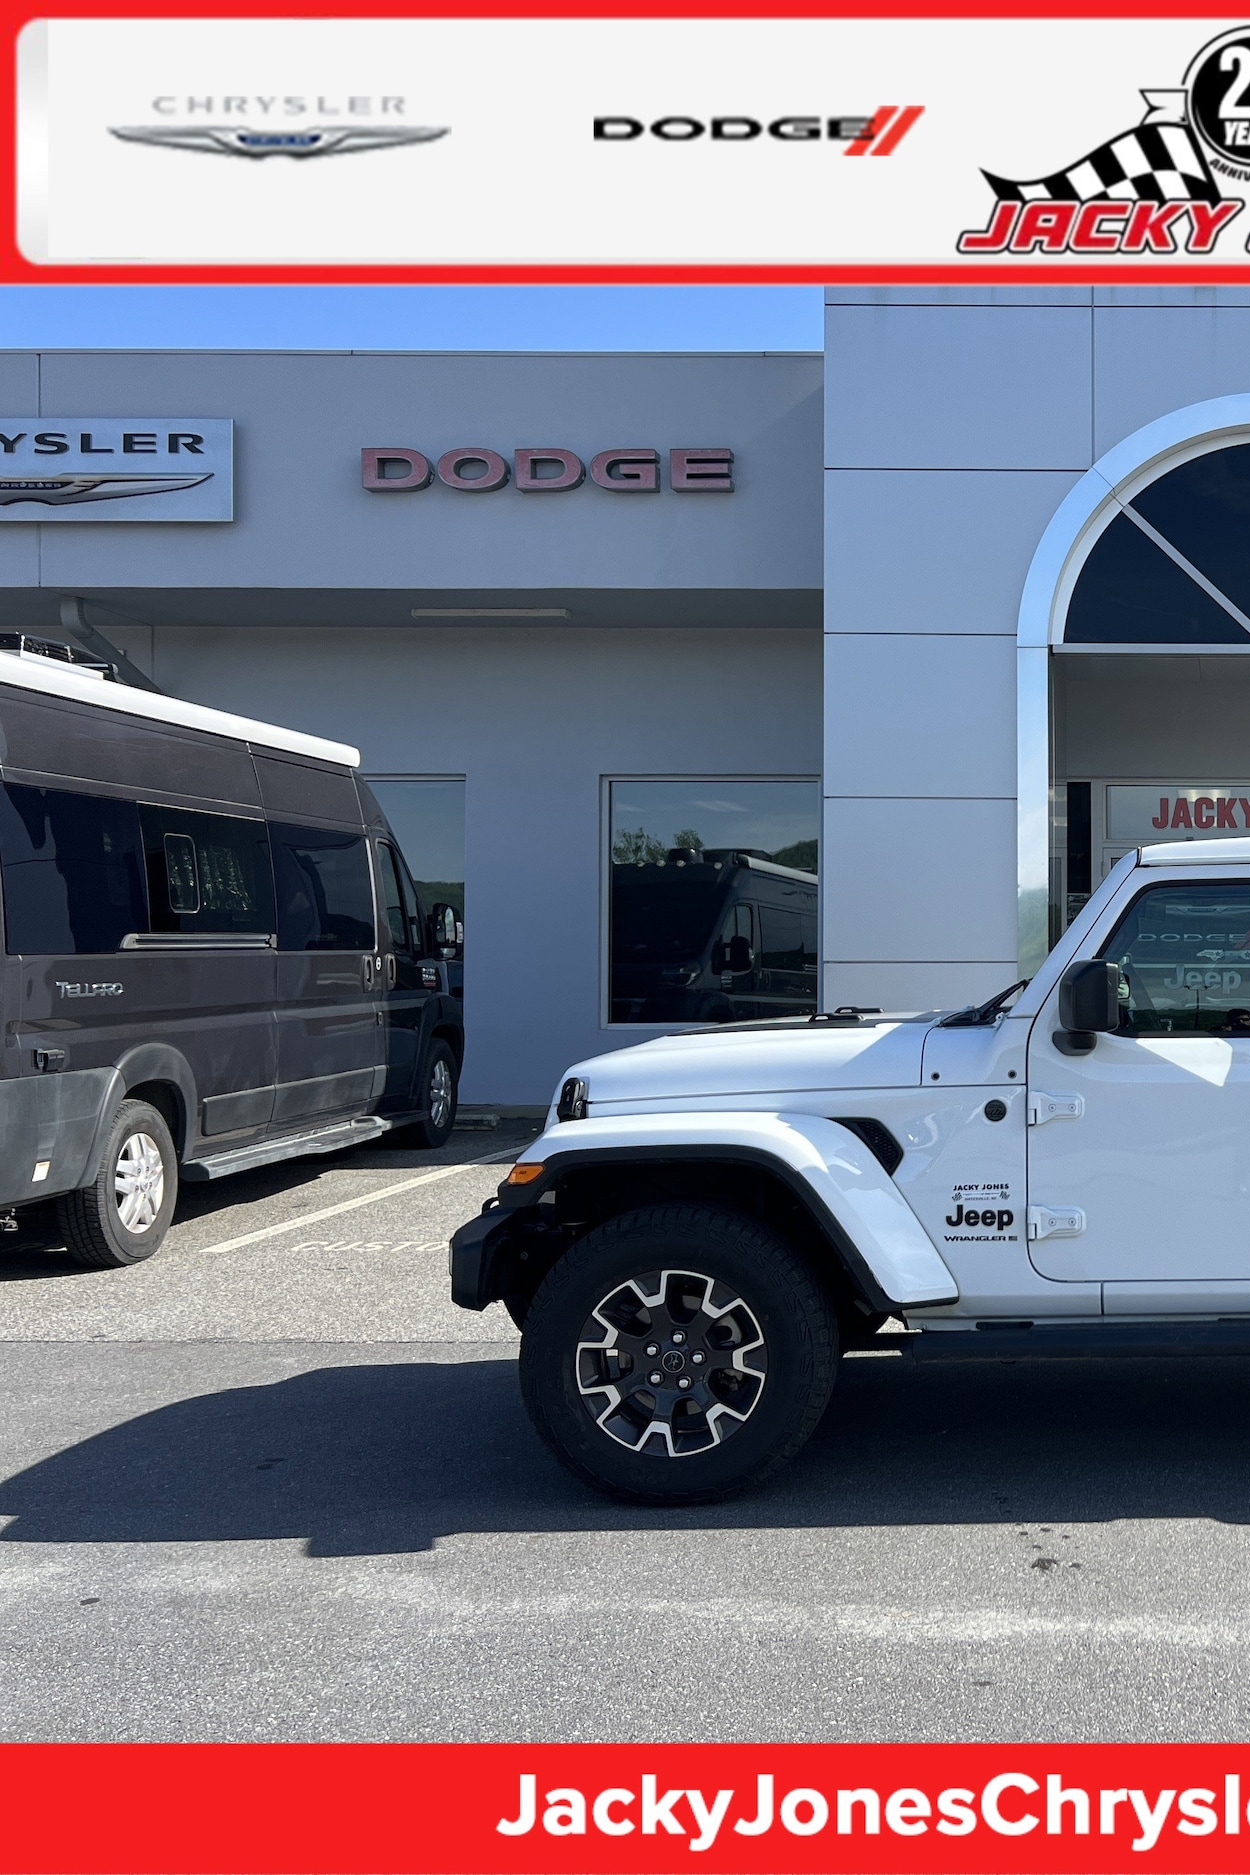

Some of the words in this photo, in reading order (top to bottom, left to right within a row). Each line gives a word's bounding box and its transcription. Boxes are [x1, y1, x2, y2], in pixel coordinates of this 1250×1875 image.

[361, 447, 735, 493] DODGE
[1137, 933, 1249, 942] DODGE
[1164, 963, 1242, 994] Jeep
[945, 1204, 1014, 1231] Jeep
